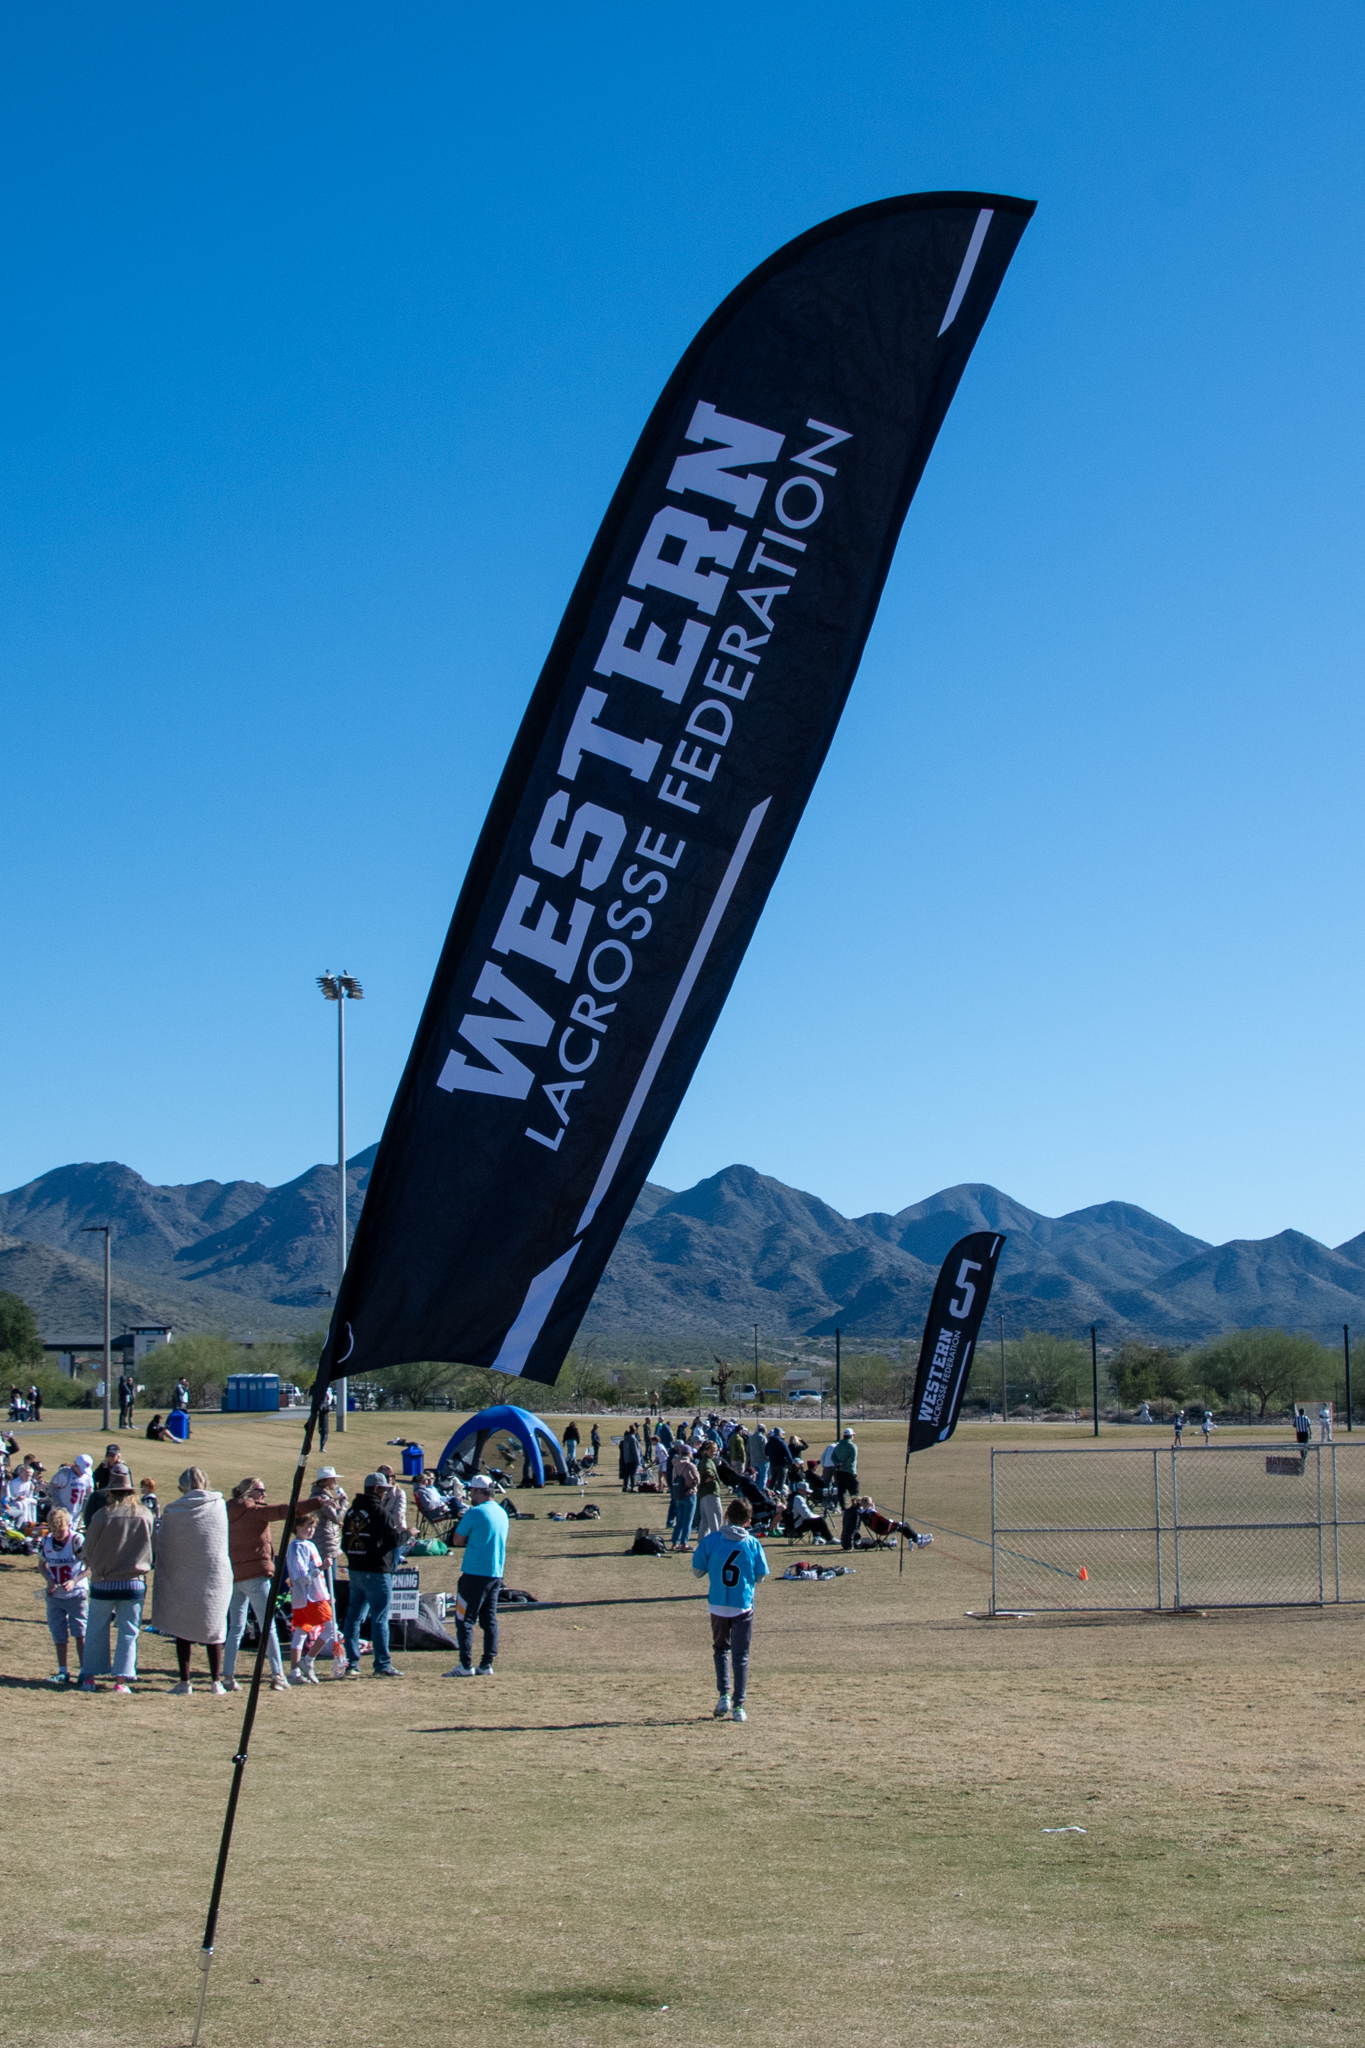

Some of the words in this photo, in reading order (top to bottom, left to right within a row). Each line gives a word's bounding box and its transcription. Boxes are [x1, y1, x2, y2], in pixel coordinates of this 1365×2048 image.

[436, 400, 786, 1100] WESTERN
[525, 822, 686, 1151] LACROSSE
[657, 417, 853, 813] FEDERATION
[949, 1258, 982, 1319] 5
[918, 1328, 953, 1421] WESTERN
[931, 1383, 948, 1427] LACROSSE
[942, 1330, 962, 1383] FEDERATION
[70, 1489, 85, 1504] 51
[391, 1574, 418, 1588] RNING
[721, 1549, 742, 1588] 6
